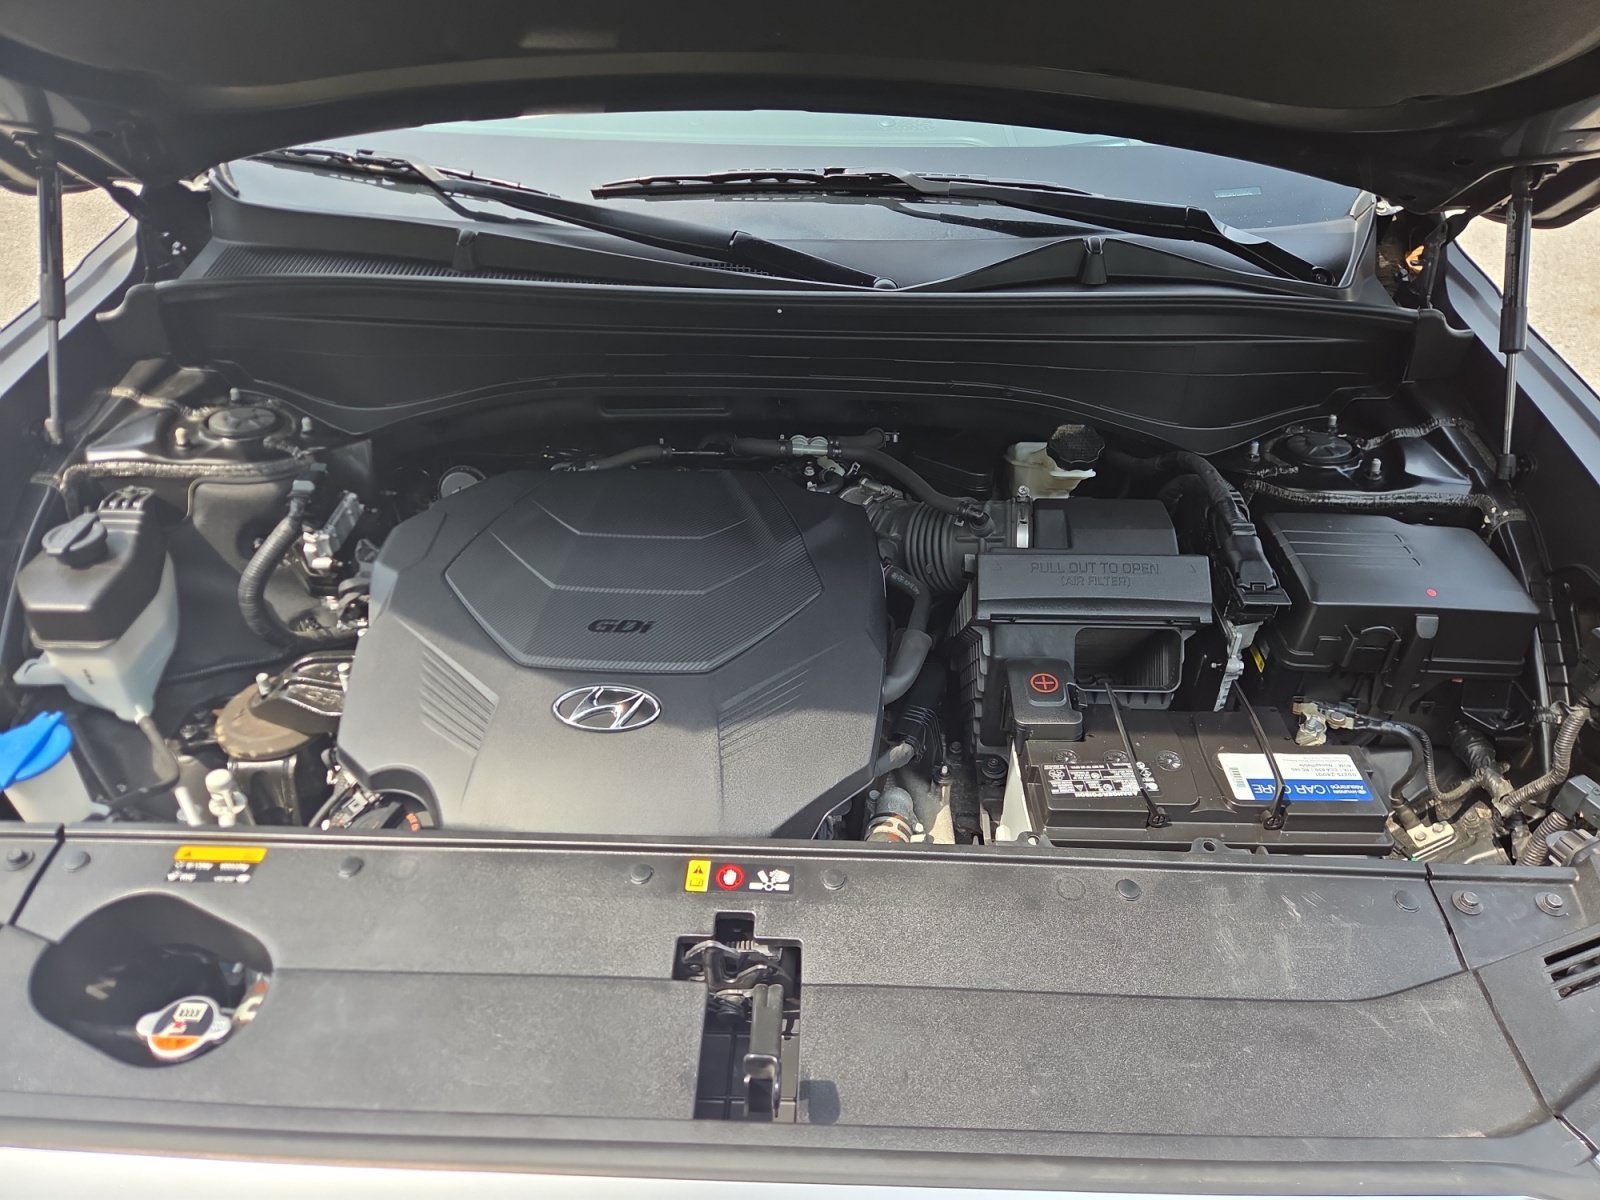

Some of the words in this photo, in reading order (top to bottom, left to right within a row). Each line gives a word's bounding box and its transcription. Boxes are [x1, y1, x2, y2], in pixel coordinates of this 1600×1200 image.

[1030, 562, 1065, 573] PULL
[1068, 562, 1097, 574] OUT
[1100, 562, 1118, 574] TO
[1122, 562, 1159, 575] OPEN
[1061, 575, 1085, 586] (AIR
[1088, 576, 1131, 588] FILTER)
[587, 619, 655, 633] GDi
[1294, 784, 1326, 794] CAR
